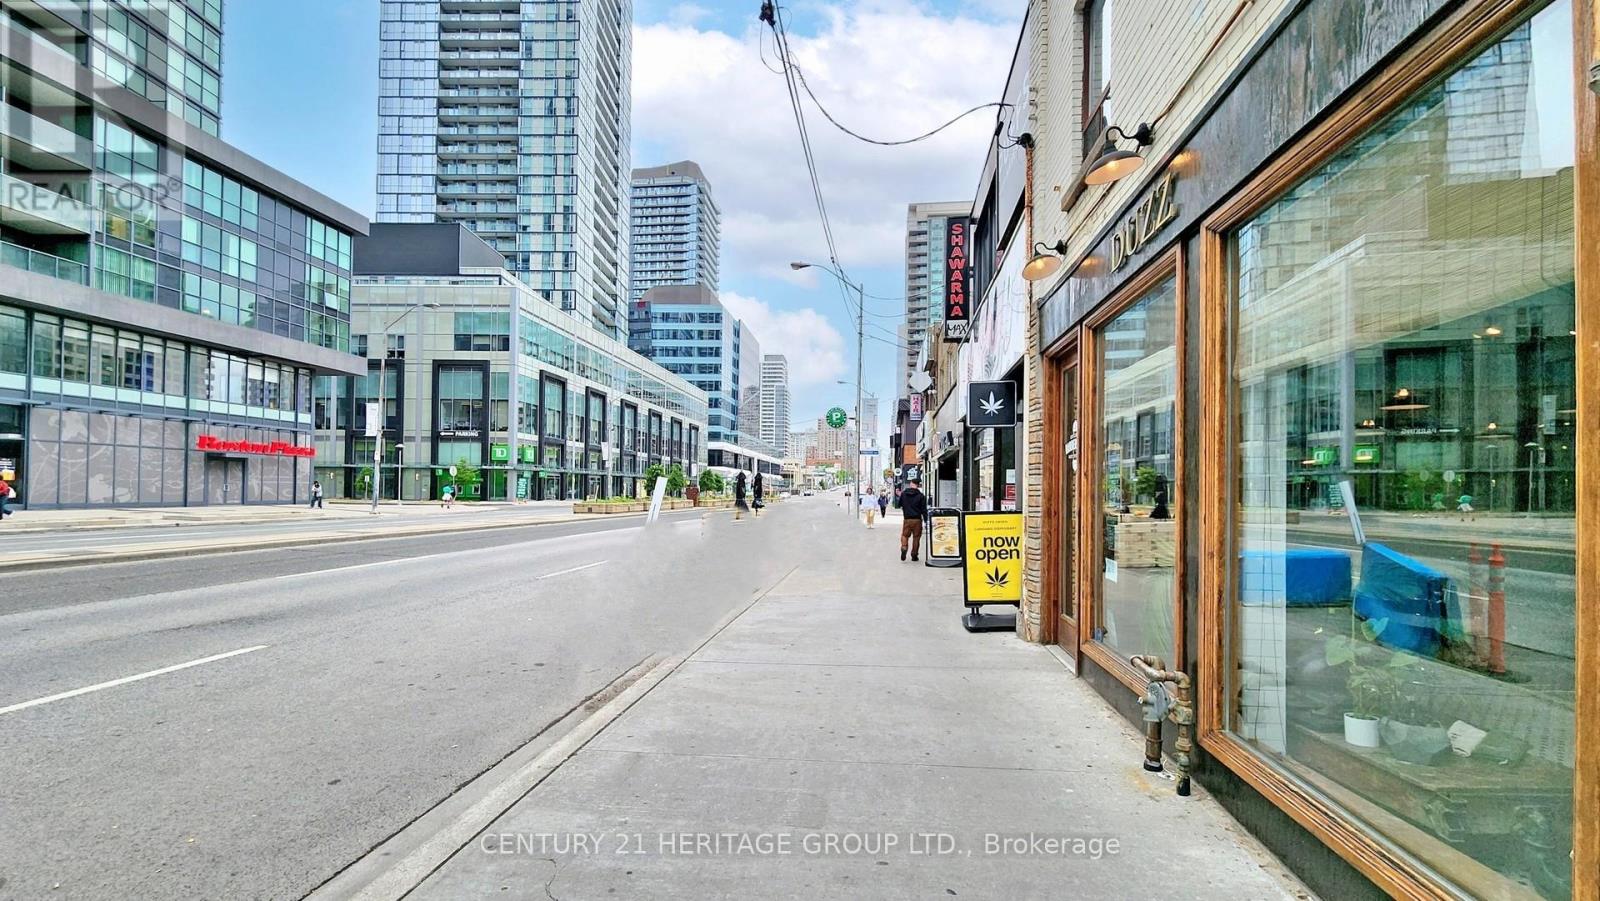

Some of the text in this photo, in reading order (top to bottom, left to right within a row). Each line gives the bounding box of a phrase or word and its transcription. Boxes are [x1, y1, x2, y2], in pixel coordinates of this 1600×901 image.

[1110, 172, 1178, 273] DUZZ
[948, 223, 966, 317] SHAWARMA
[947, 322, 967, 335] MAX
[832, 412, 841, 422] P
[494, 448, 507, 458] TD
[983, 536, 1020, 548] now
[975, 548, 1020, 564] open
